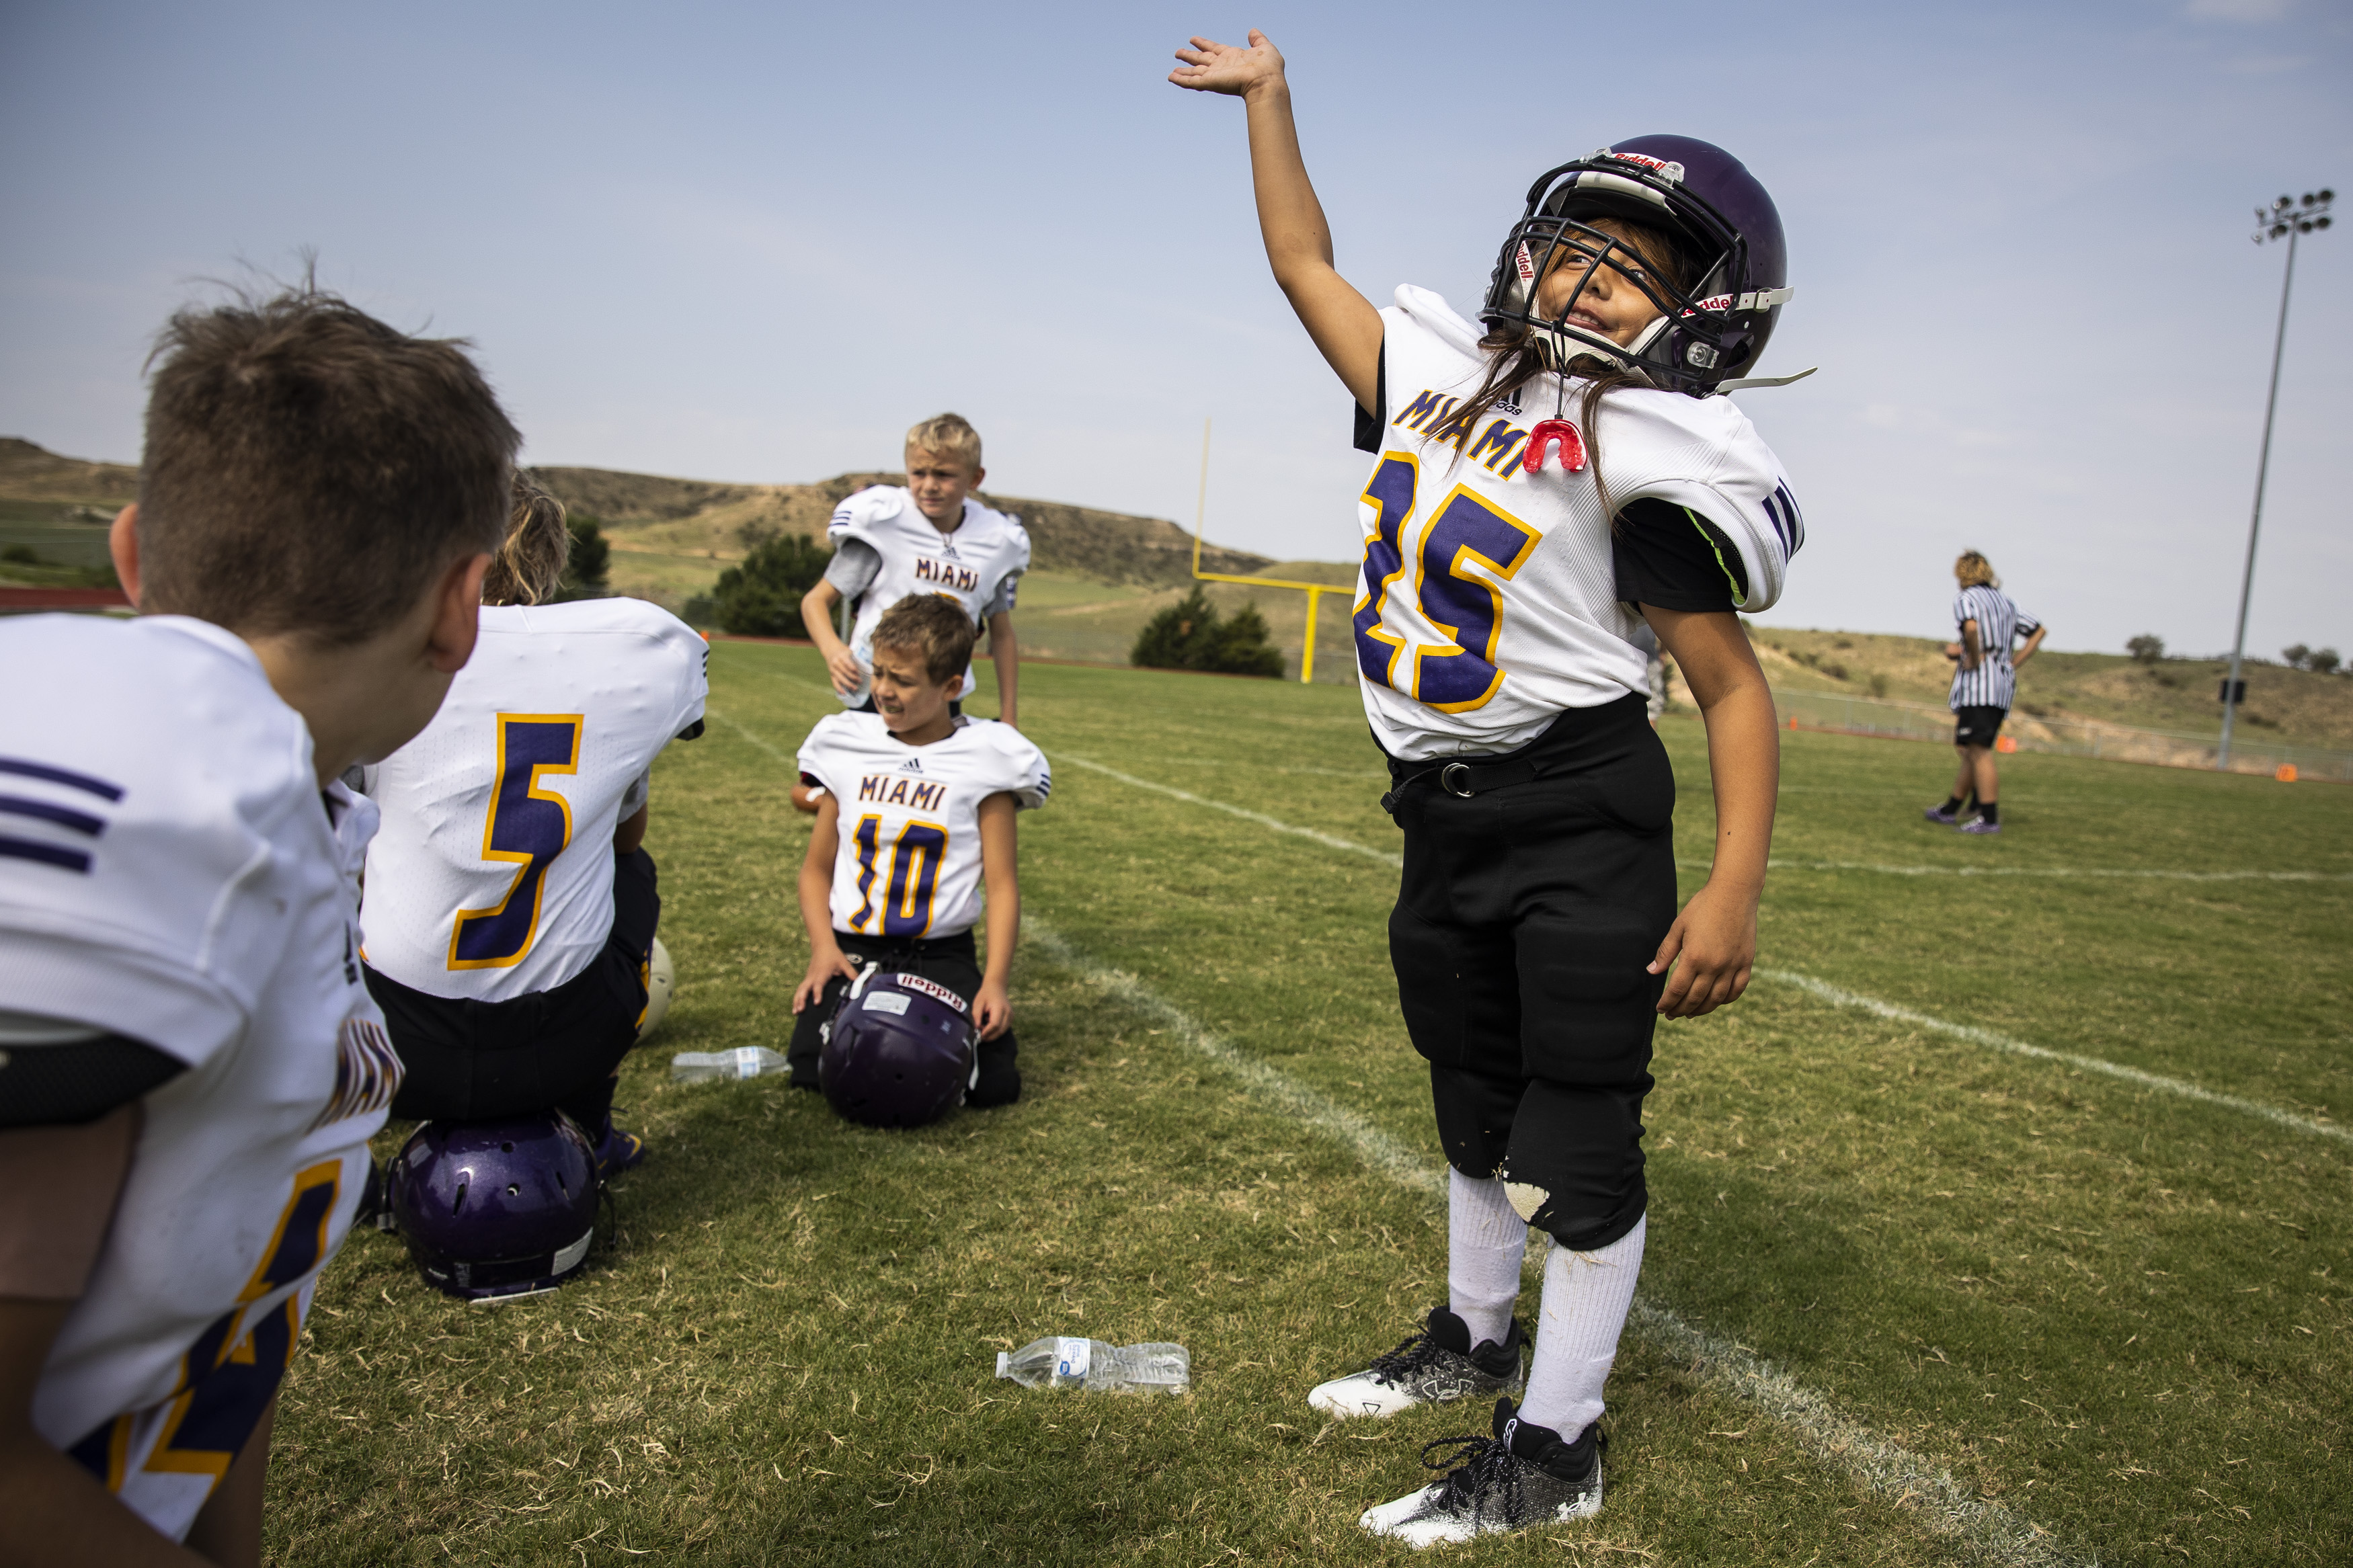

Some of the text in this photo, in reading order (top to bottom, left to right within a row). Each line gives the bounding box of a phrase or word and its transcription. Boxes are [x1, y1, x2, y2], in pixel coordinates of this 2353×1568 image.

[1392, 389, 1529, 481] MIAMI
[915, 557, 980, 592] MIAMI
[1353, 450, 1543, 714] 25
[447, 712, 584, 971] 5
[858, 774, 947, 811] MIAMI
[848, 813, 949, 938] 10
